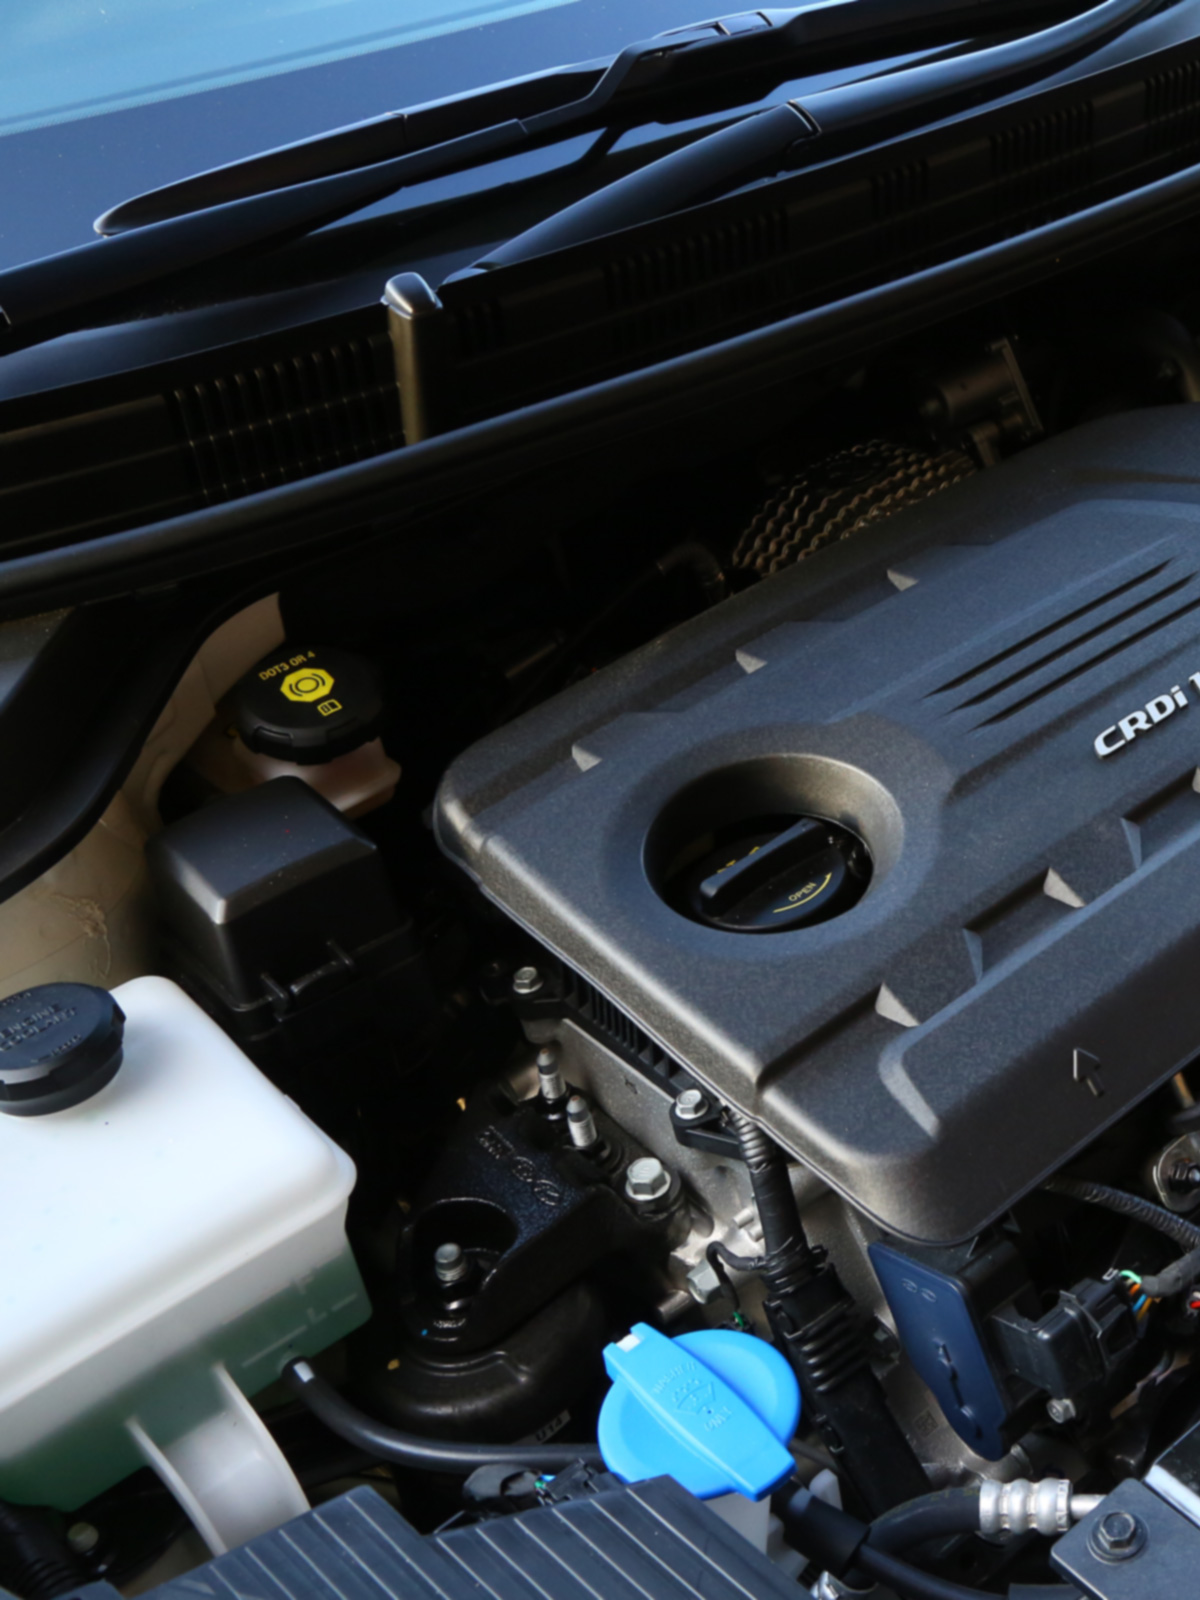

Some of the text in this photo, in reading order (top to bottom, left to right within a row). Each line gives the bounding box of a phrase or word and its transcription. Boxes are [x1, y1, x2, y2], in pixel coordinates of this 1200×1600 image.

[258, 650, 316, 681] DOT3 OR 4
[1093, 684, 1189, 759] CRDi
[788, 881, 817, 903] OPEN
[0, 1003, 63, 1040] ENGINE
